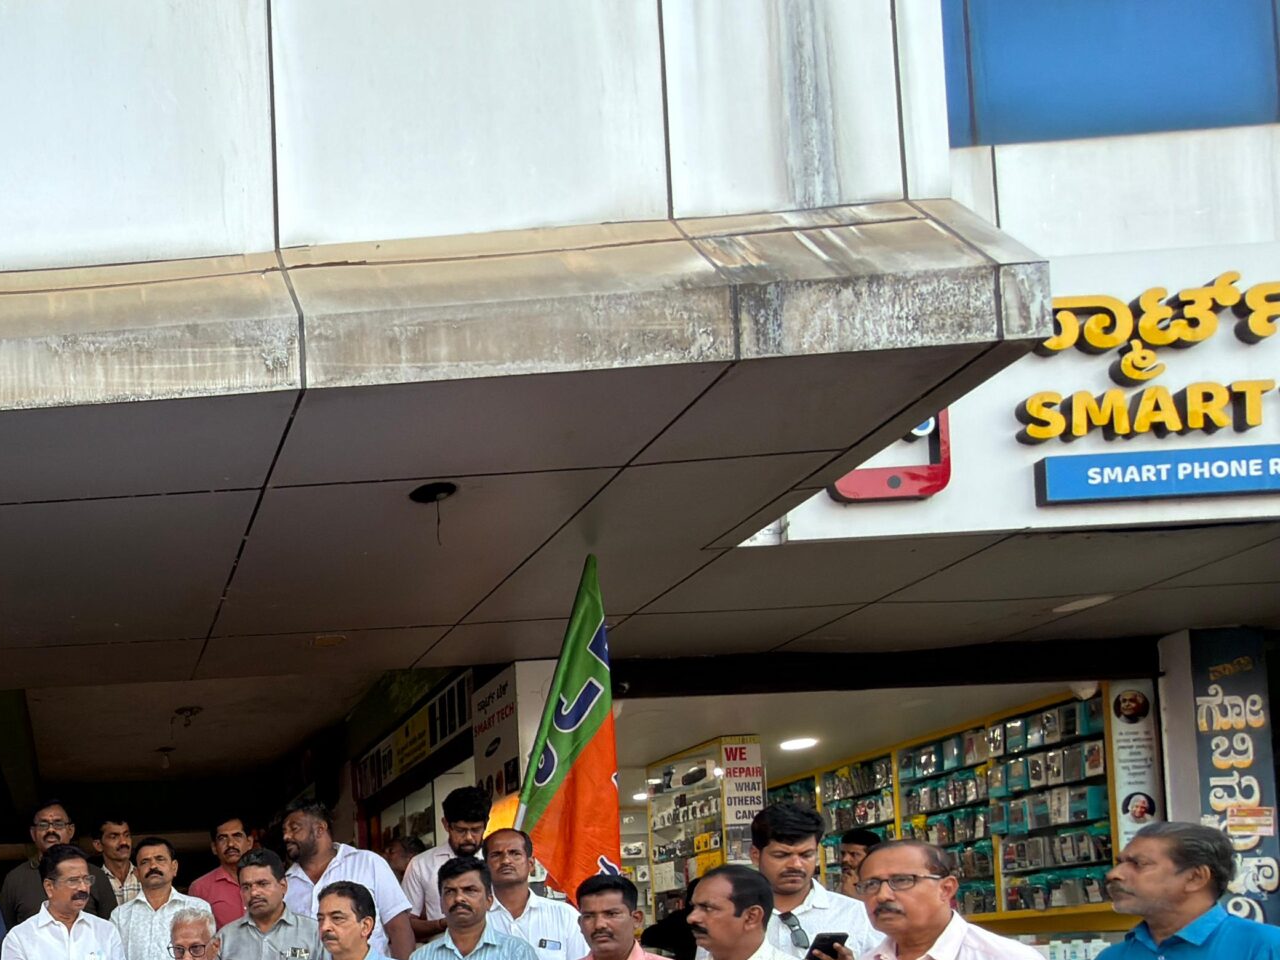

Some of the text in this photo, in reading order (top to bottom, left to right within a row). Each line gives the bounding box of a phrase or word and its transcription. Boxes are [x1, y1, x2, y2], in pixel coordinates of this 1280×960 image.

[1025, 379, 1276, 439] SMART
[1087, 464, 1172, 485] SMART
[1177, 459, 1263, 480] PHONE
[474, 702, 515, 738] SMART TECH
[724, 746, 747, 762] WE
[725, 766, 762, 778] REPAIR
[735, 781, 761, 792] WHAT
[726, 796, 761, 807] OTHERS
